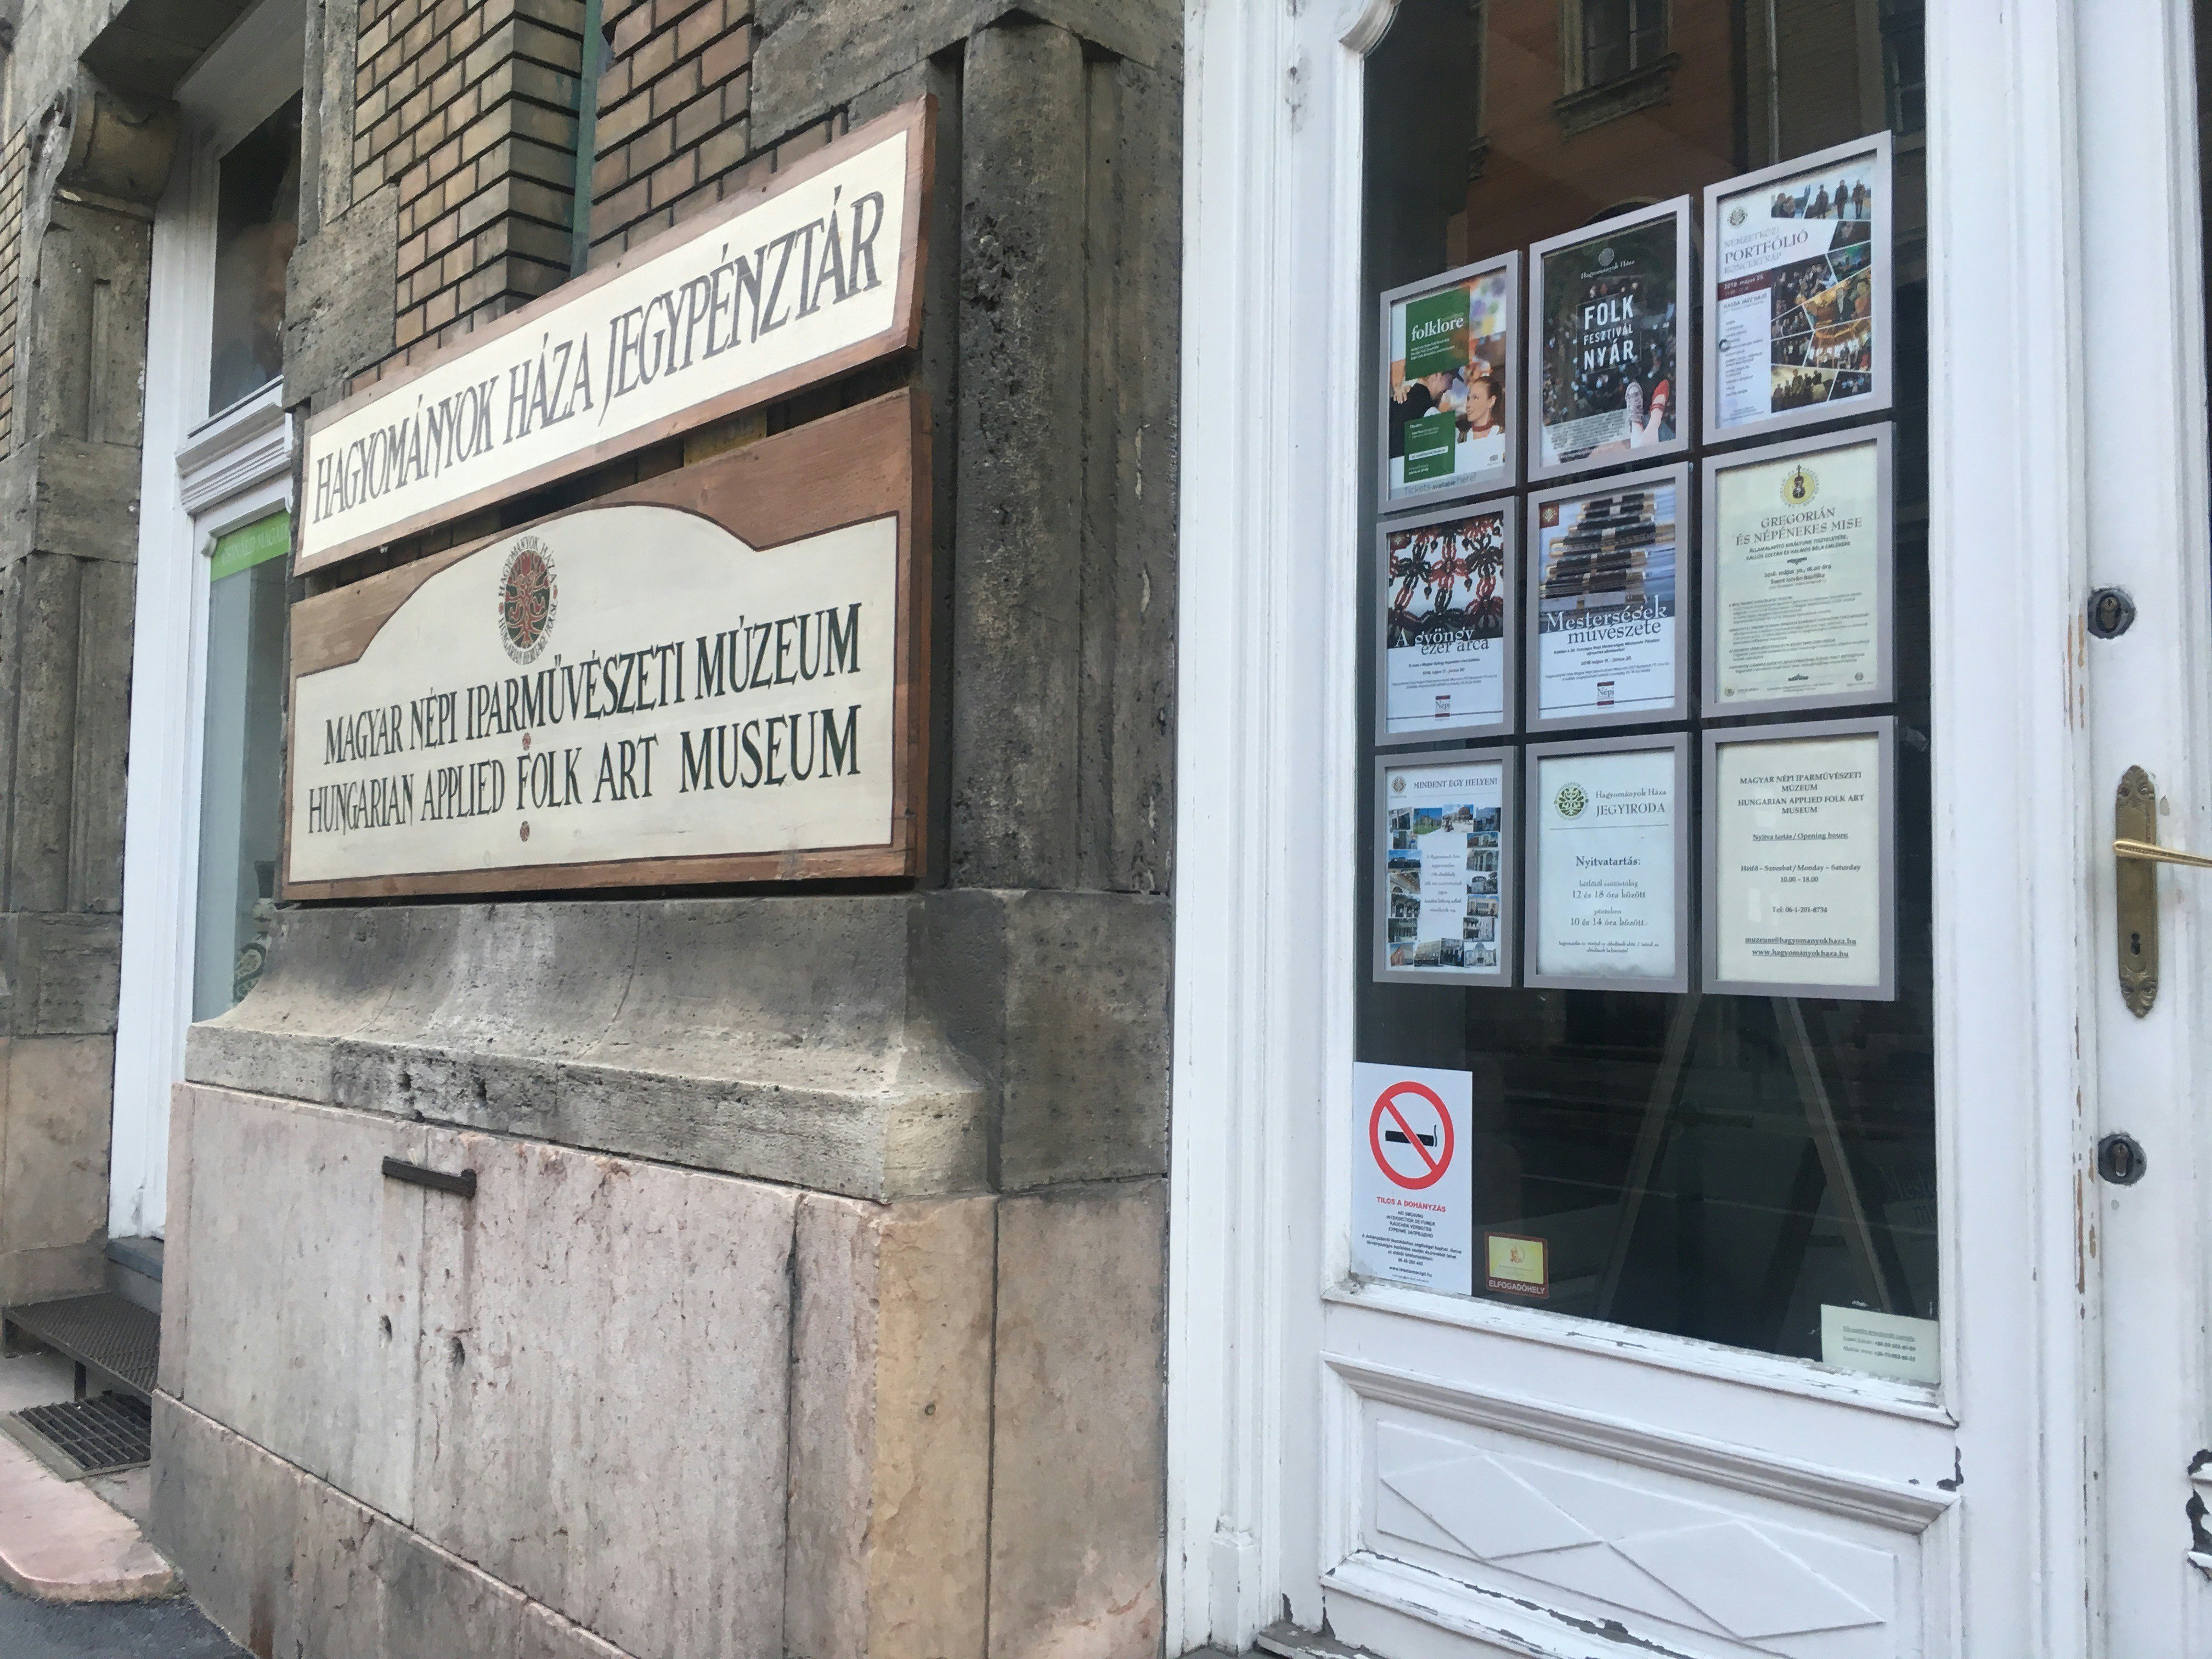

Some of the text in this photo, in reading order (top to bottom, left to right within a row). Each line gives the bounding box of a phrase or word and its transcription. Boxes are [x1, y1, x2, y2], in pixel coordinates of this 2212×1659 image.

[1725, 228, 1808, 264] PORTFÓLIÓ
[1585, 295, 1633, 330] FOLK
[1411, 317, 1464, 341] folklore
[1584, 323, 1633, 346] FESZTIVÁL
[313, 185, 885, 523] HAGYOMÁNYOK HÁZA JEGYPÉNZTÁR
[1584, 338, 1635, 370] NYÁR
[1404, 483, 1430, 495] Tickets
[1432, 481, 1455, 489] available
[1761, 506, 1836, 529] GREGORIÁN
[1736, 517, 1862, 546] ÉS NÉPÉNEKES MISE
[1545, 594, 1667, 633] Mesterségek
[1394, 626, 1475, 647] A gyöngy
[1567, 619, 1661, 644] művészete
[1421, 639, 1489, 655] ezer arca
[323, 602, 862, 764] MAGYAR NÉPI IPARMŰVÉSZETI MÚZEUM
[1597, 687, 1614, 698] Népi
[1436, 701, 1451, 710] Népi
[308, 704, 862, 834] HUNGARIAN APPLIED FOLK ART MUSEUM
[1413, 780, 1447, 789] MINDENT
[1449, 779, 1464, 788] EGY
[1776, 774, 1794, 782] NÉPI
[1596, 788, 1646, 799] Hagyományok
[1782, 784, 1818, 792] MÚZEUM
[1738, 798, 1787, 806] HUNGARIAN
[1596, 803, 1665, 817] JEGYIRODA
[1797, 833, 1826, 841] Opening
[1576, 855, 1641, 868] Nyitvatartás:
[1621, 889, 1646, 898] között
[1594, 906, 1622, 915] pénteken
[1571, 917, 1579, 926] 10
[1593, 917, 1602, 926] 14
[1745, 937, 1857, 946] muzeum@hagyomanyokhaza.hu
[1752, 949, 1849, 958] www.hagyomanyokhaza.hu
[1376, 1196, 1395, 1205] TILOS
[1404, 1200, 1446, 1212] DOHÁNYZÁS
[1489, 1280, 1545, 1294] ELFOGADÓHELY
